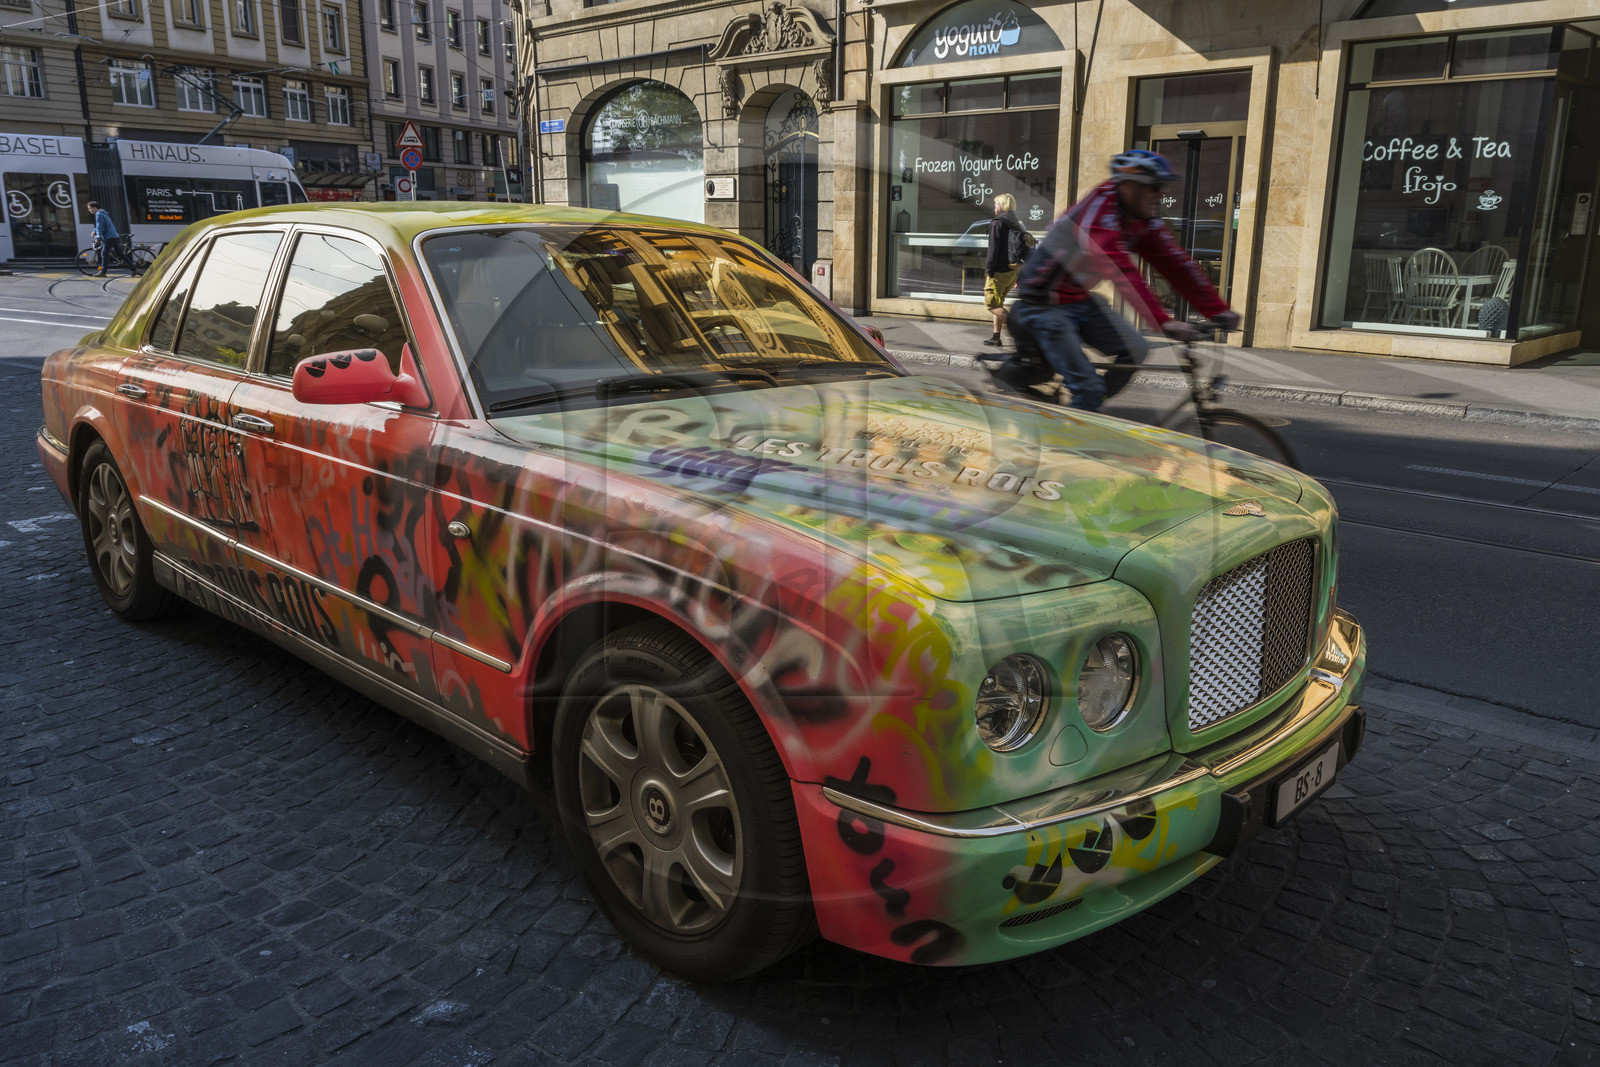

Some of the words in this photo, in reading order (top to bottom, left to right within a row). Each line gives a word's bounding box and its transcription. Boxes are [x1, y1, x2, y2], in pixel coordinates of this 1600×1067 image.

[934, 12, 1002, 59] yogurt
[484, 90, 494, 100] 30
[650, 114, 682, 126] BACHMANN
[0, 136, 71, 156] BASEL
[130, 143, 206, 163] HINAUS.
[1361, 137, 1439, 162] Coffee
[1446, 138, 1463, 159] &
[1472, 136, 1512, 159] Tea
[915, 157, 956, 173] Frozen
[959, 154, 1003, 177] Yogurt
[1006, 152, 1039, 171] Cafe
[146, 188, 173, 197] PARIS.
[962, 177, 993, 205] frojo
[1403, 166, 1457, 204] frojo
[728, 434, 811, 458] LES
[816, 446, 945, 479] TROIS
[953, 467, 1067, 502] ROIS
